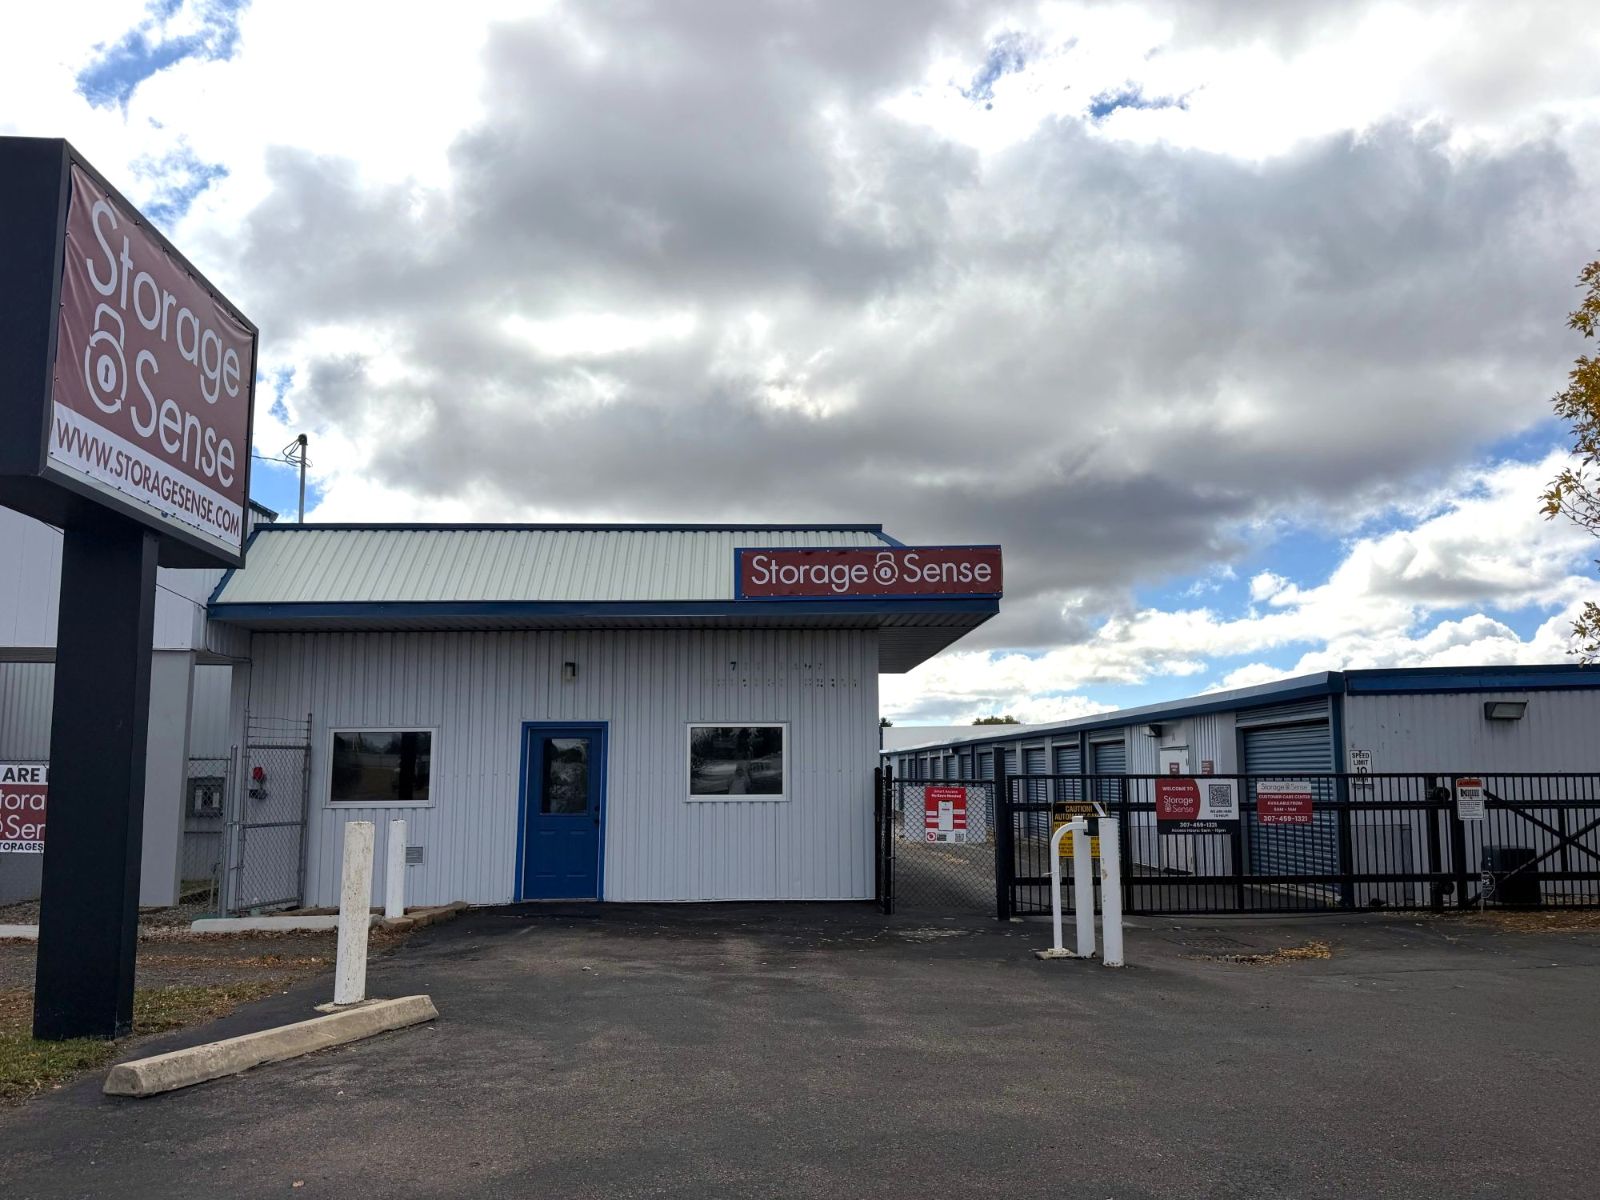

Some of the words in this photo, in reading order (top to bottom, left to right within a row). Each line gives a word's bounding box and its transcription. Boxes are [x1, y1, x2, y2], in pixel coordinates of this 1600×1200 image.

[86, 200, 240, 404] Storage
[130, 350, 235, 487] Sense
[56, 418, 240, 538] WWW.STORAGESENSE.COM
[751, 555, 869, 593] Storage
[903, 553, 992, 583] Sense
[2, 767, 41, 783] ARE
[1356, 766, 1368, 774] 10
[1261, 782, 1285, 791] Storage
[0, 788, 46, 811] tora
[1163, 795, 1194, 806] Storage
[1172, 804, 1194, 812] Sense
